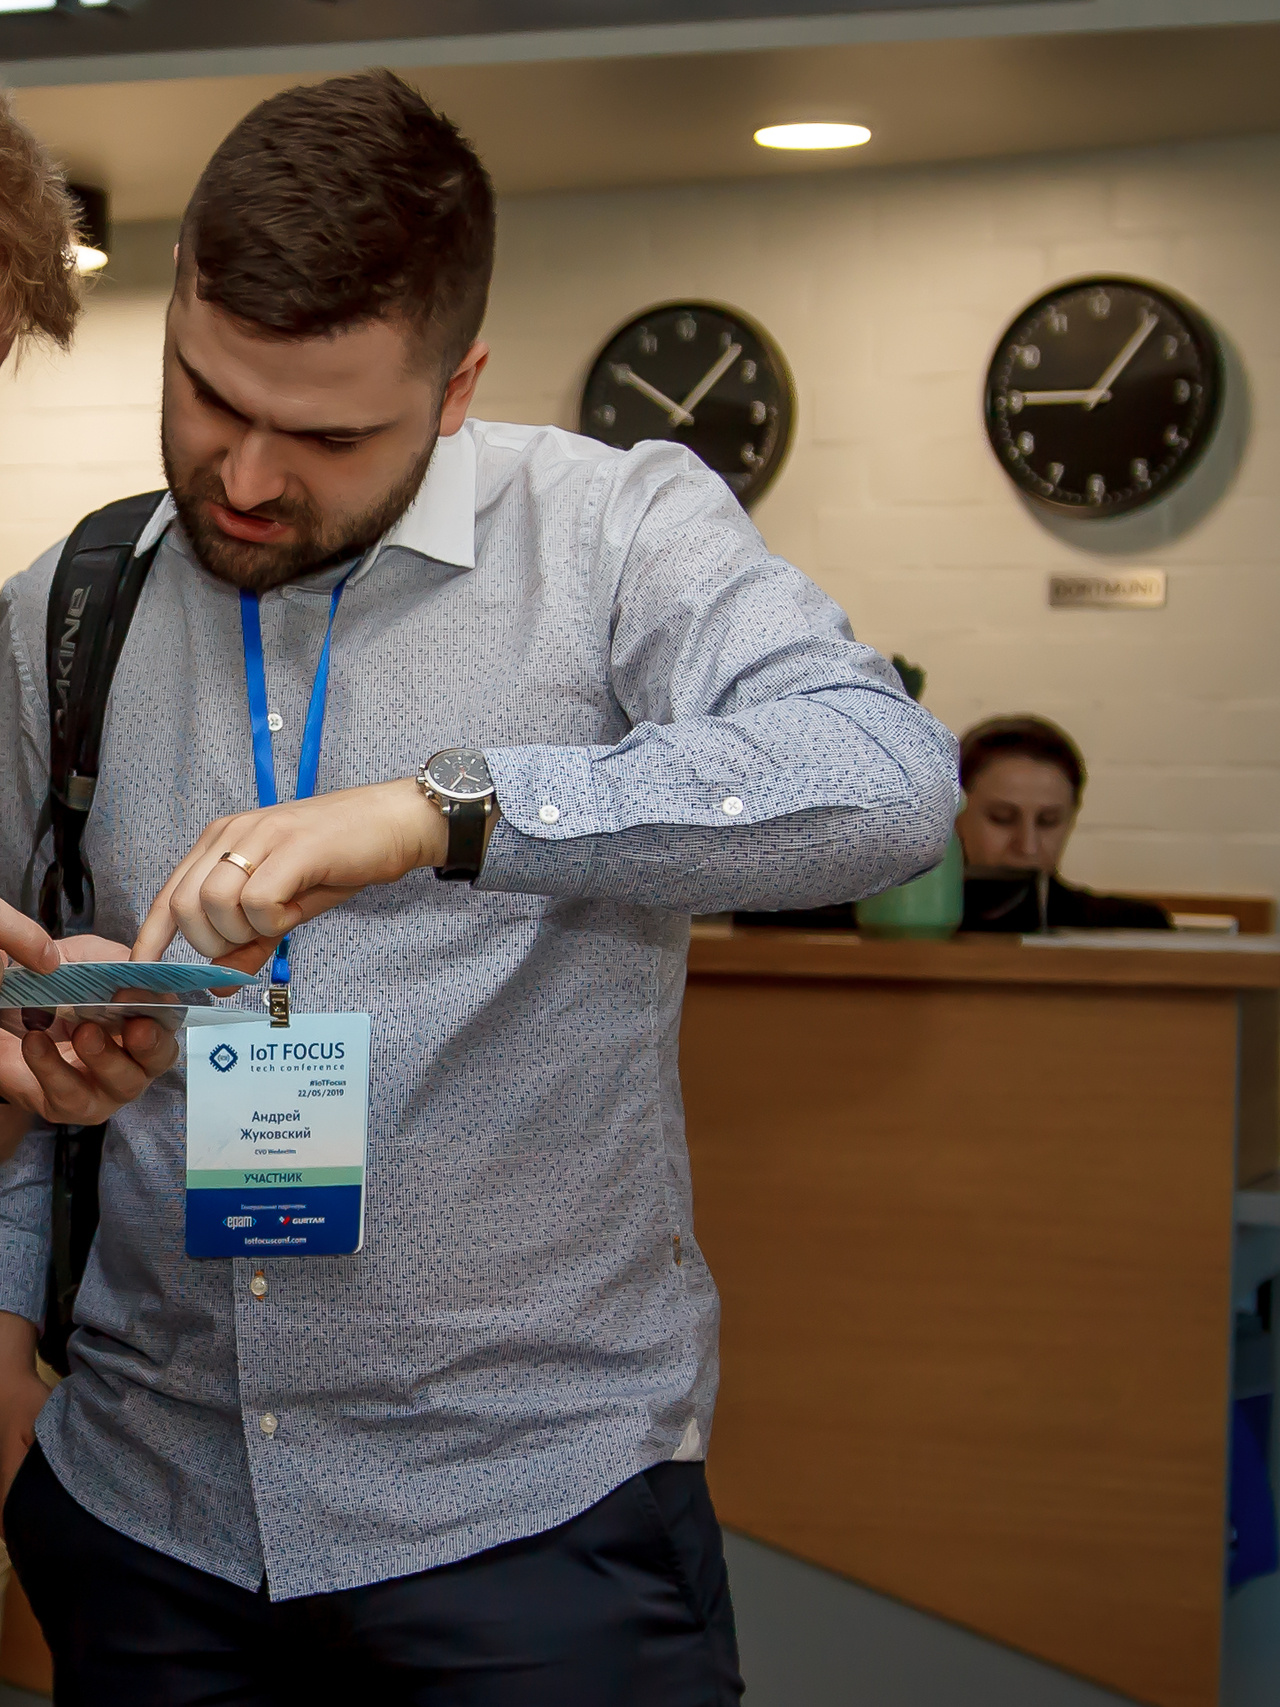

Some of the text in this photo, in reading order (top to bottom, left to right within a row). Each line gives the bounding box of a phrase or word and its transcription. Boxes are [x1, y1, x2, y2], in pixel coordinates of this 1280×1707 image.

[250, 1042, 345, 1061] IoT FOCUS
[250, 1063, 345, 1072] tech conference
[298, 1089, 344, 1098] 22/05/2019
[251, 1109, 301, 1125] Андрей
[240, 1127, 311, 1143] Жуковский
[243, 1173, 303, 1183] УЧАСТНИК
